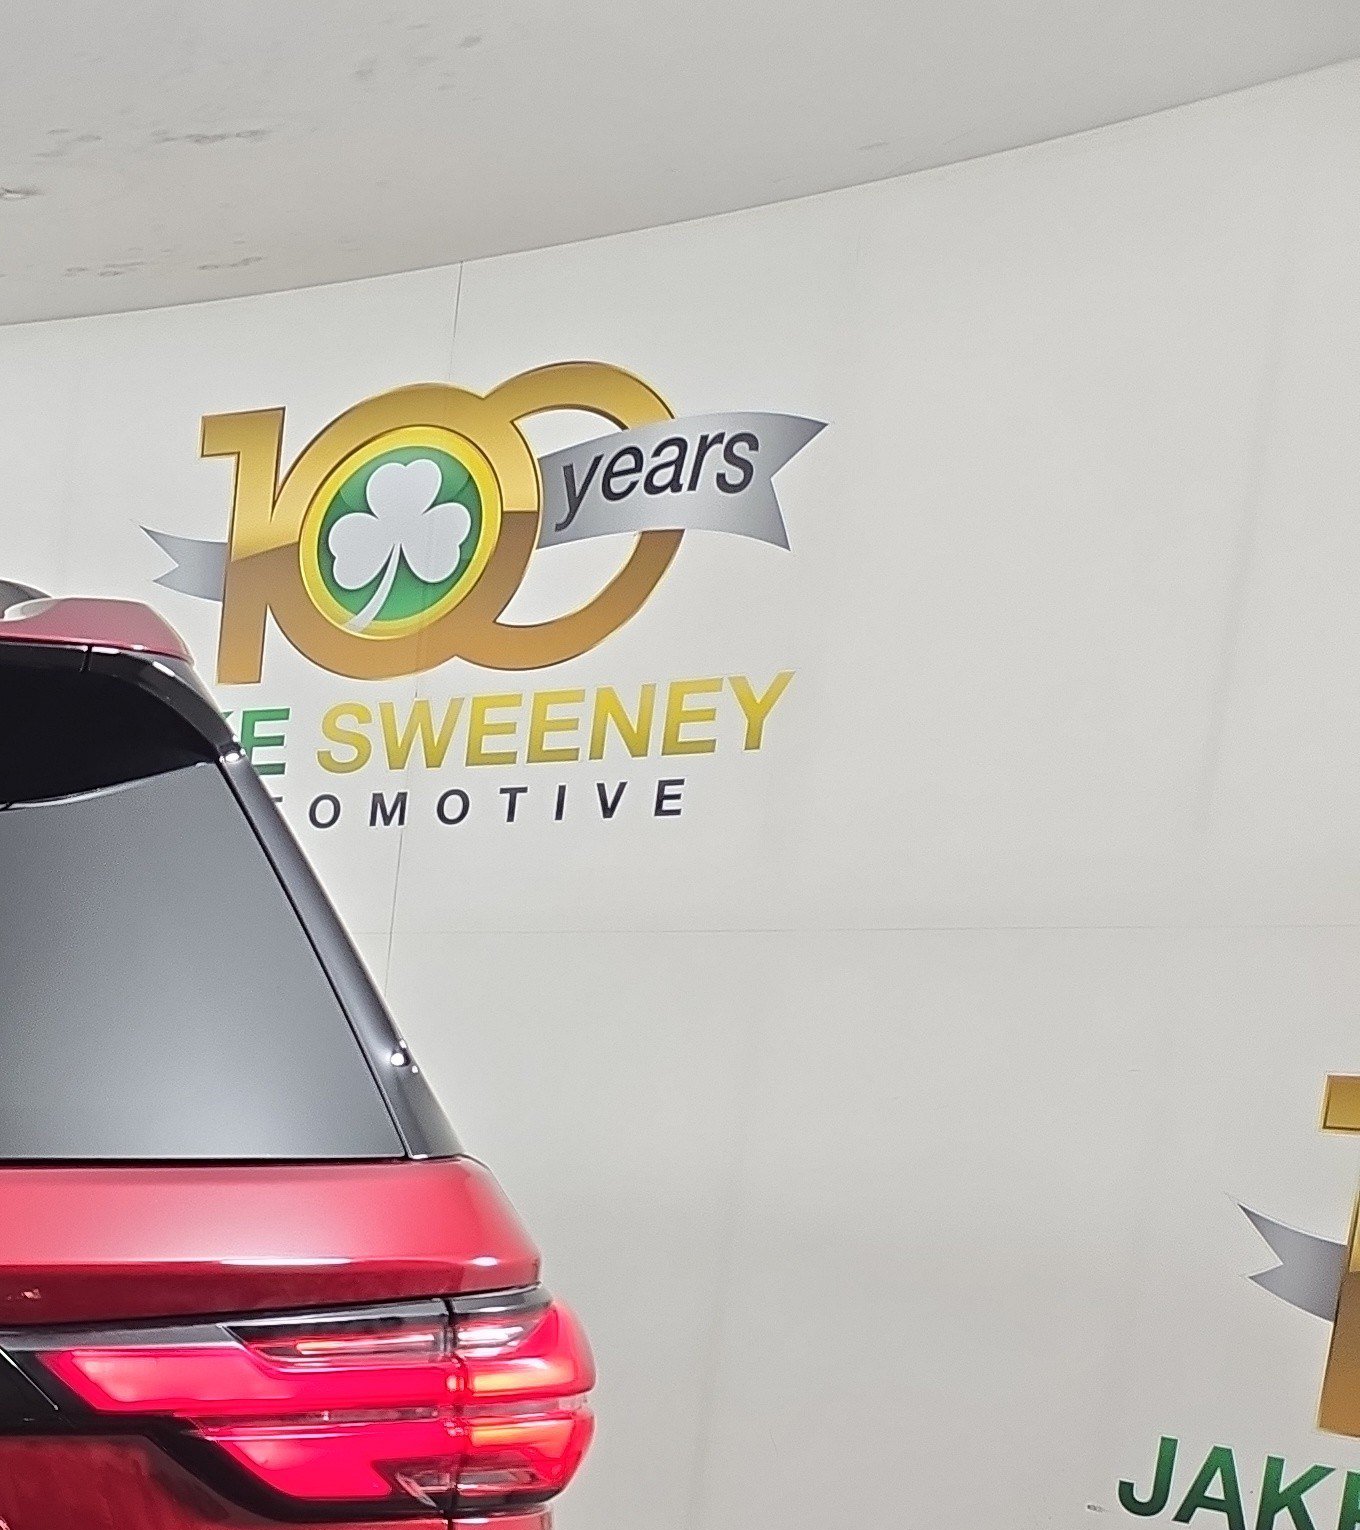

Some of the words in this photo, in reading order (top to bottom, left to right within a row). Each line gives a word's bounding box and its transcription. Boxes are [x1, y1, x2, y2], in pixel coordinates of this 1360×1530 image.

[555, 429, 760, 532] years
[317, 671, 795, 773] SWEENEY
[272, 778, 687, 828] OMOTIVE
